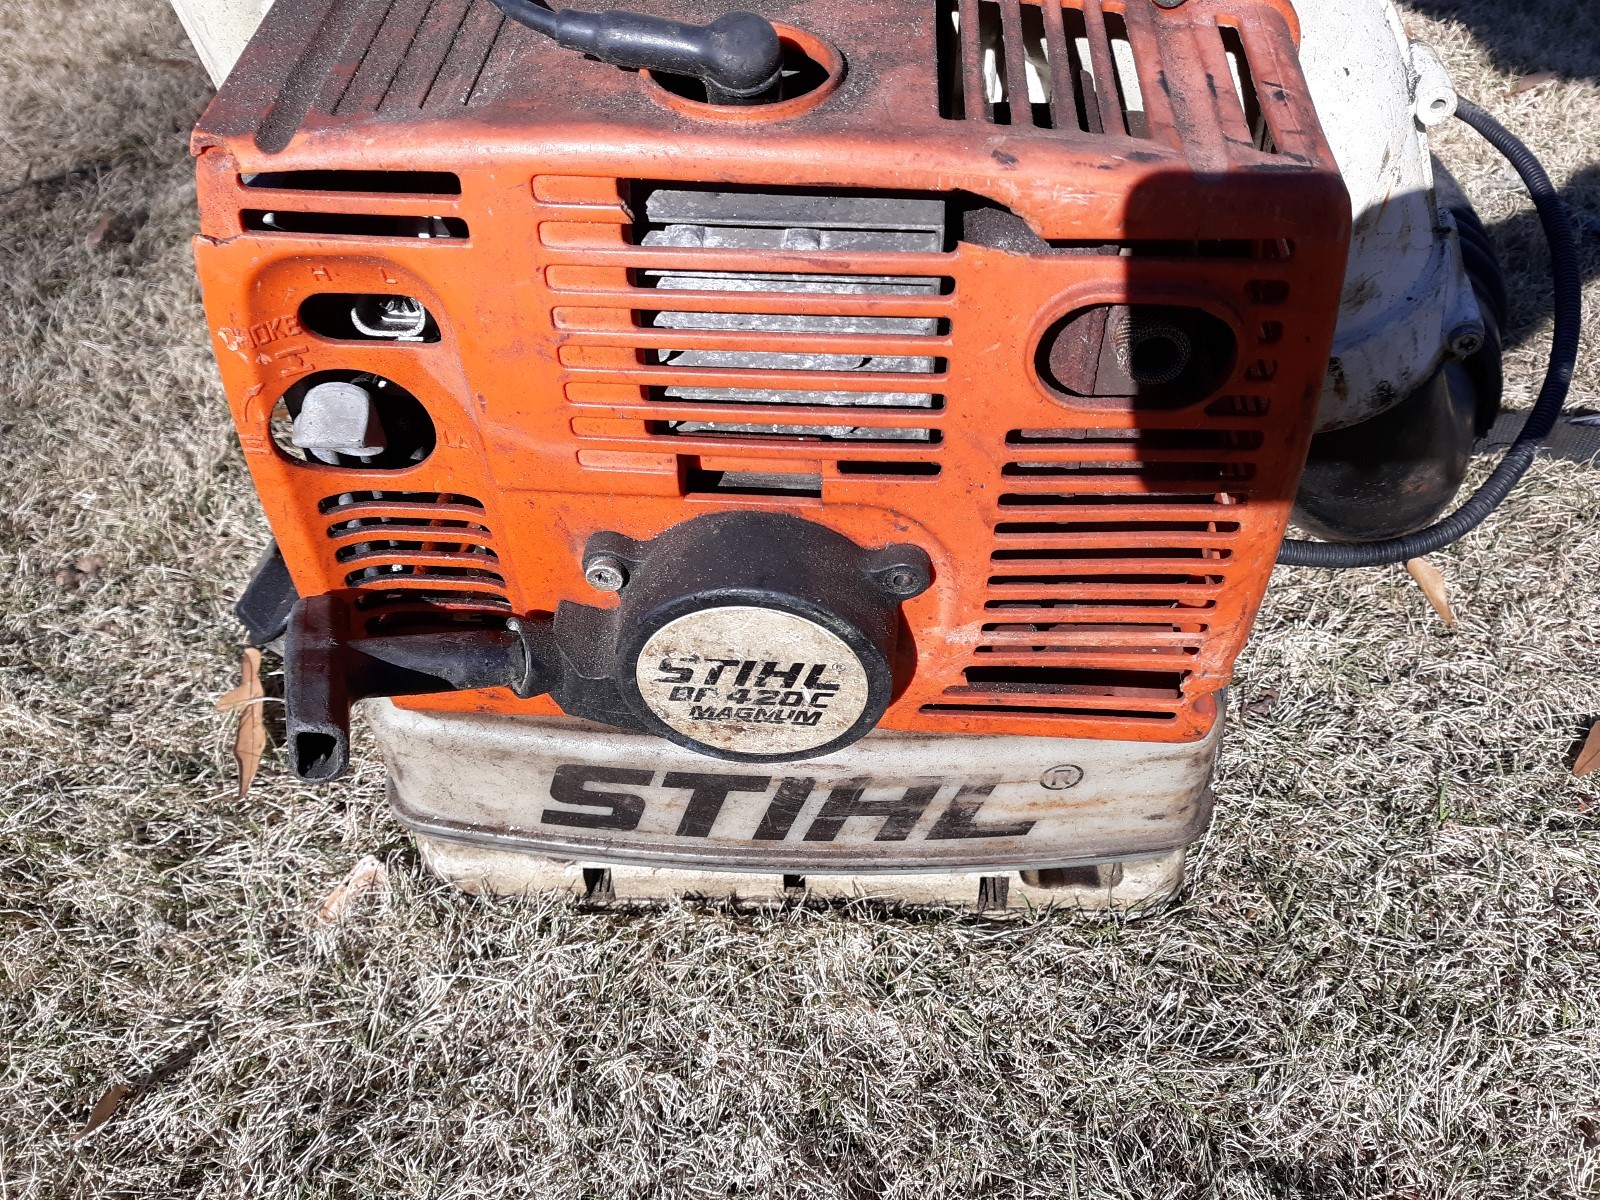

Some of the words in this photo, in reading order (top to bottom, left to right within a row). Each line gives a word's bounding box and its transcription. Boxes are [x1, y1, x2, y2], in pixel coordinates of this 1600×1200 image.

[653, 654, 840, 691] STIHL
[689, 705, 823, 726] MAGNUM
[541, 764, 1037, 841] STIHL
